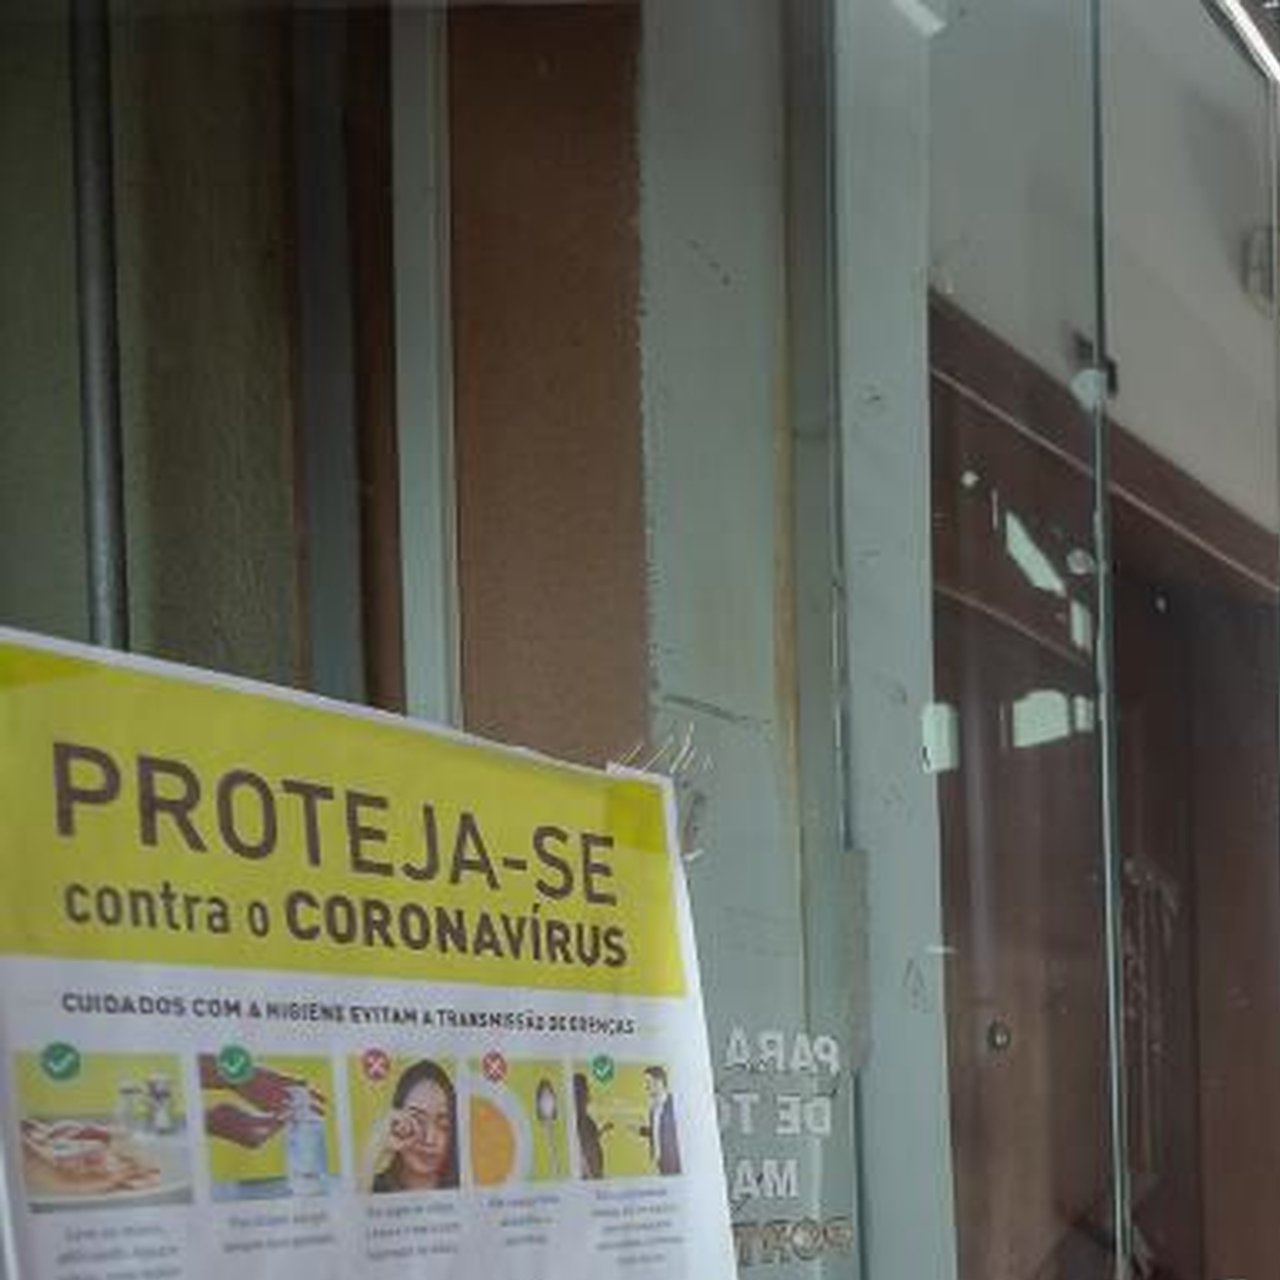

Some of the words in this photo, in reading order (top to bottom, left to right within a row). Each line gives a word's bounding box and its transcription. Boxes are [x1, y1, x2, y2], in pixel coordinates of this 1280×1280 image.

[53, 742, 617, 905] PROTEJA-SE
[65, 881, 231, 933] contra
[249, 901, 270, 936] o
[286, 889, 627, 967] CORONAVÍRUS
[62, 992, 186, 1016] CUIDADOS
[192, 998, 241, 1018] COM
